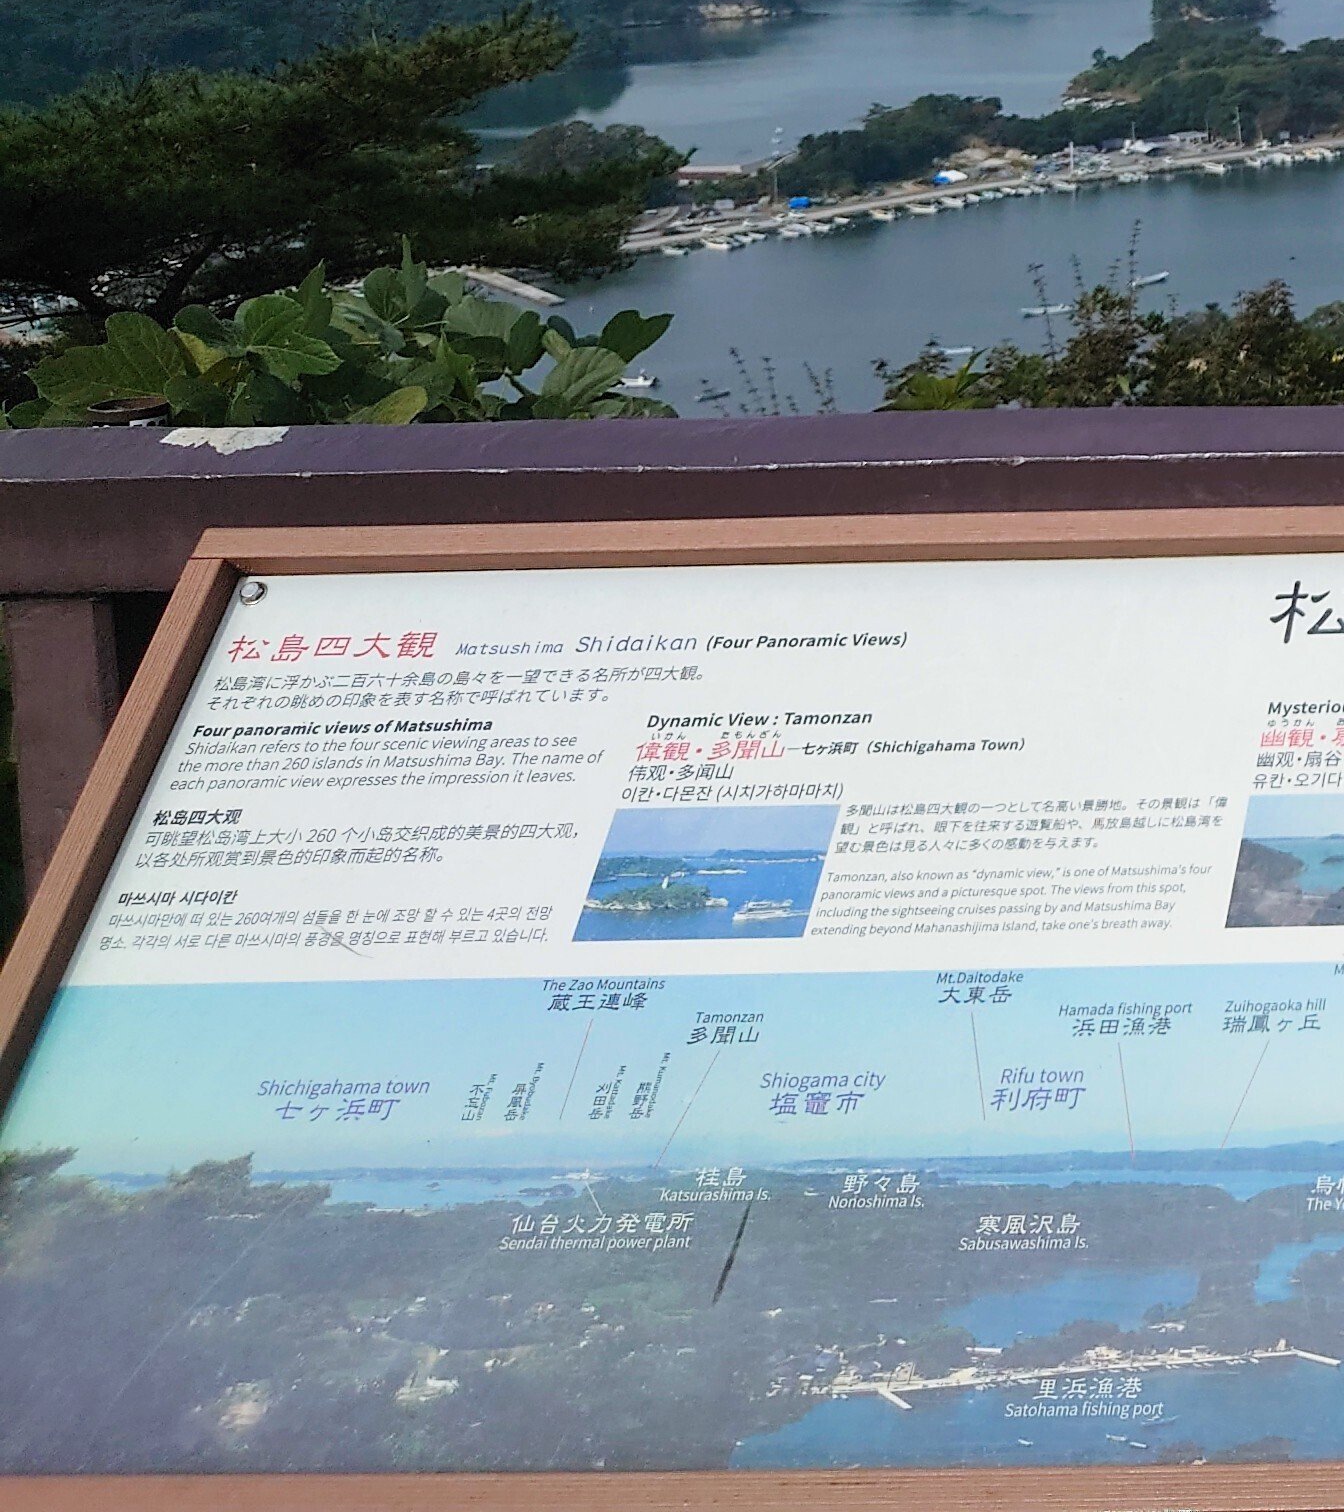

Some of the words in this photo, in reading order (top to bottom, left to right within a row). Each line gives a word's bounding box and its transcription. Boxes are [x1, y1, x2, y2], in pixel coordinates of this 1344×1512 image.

[454, 640, 564, 656] Matsushima
[574, 633, 697, 653] Shidaikan
[705, 634, 754, 652] (Four
[755, 632, 848, 648] Panoramic
[852, 631, 907, 648] Views)
[191, 724, 232, 738] Four
[230, 720, 321, 741] panoramic
[324, 720, 371, 740] views
[373, 718, 394, 733] of
[392, 717, 493, 733] Matsushima
[645, 711, 724, 731] Dynamic
[722, 711, 770, 733] View
[783, 711, 873, 725] Tamonzan
[183, 735, 257, 755] Shidaikan
[258, 738, 301, 754] refers
[303, 739, 320, 753] to
[321, 737, 347, 752] the
[348, 736, 381, 752] four
[380, 736, 429, 751] scenic
[431, 735, 488, 752] viewing
[488, 736, 531, 754] areas
[532, 735, 549, 747] to
[550, 735, 578, 747] see
[541, 977, 567, 992] The
[566, 978, 594, 991] Zao
[595, 976, 666, 991] Mountains
[695, 1010, 764, 1024] Tamonzan
[1058, 1003, 1115, 1017] Hamada
[1116, 1002, 1162, 1018] fishing
[1163, 1002, 1194, 1016] port
[1223, 997, 1303, 1017] Zuihogaoka
[1304, 997, 1327, 1016] hill
[758, 1071, 849, 1093] Shiogama
[849, 1069, 886, 1092] city
[999, 1065, 1035, 1085] Rifu
[1039, 1067, 1084, 1084] town
[256, 1077, 382, 1100] Shichigahama
[384, 1079, 430, 1094] town
[658, 1186, 754, 1201] Katsurashima
[756, 1186, 770, 1200] Is.
[828, 1194, 907, 1209] Nonoshima
[910, 1194, 925, 1207] Is.
[1305, 1196, 1332, 1211] The
[498, 1235, 549, 1250] Sendai
[549, 1234, 605, 1249] thermal
[605, 1237, 652, 1252] power
[652, 1233, 690, 1252] plant
[957, 1235, 1071, 1250] Sabusawashima
[1073, 1235, 1088, 1248] Is.
[1003, 1401, 1078, 1417] Satohama
[1081, 1400, 1130, 1419] fishing
[1131, 1401, 1164, 1420] port
